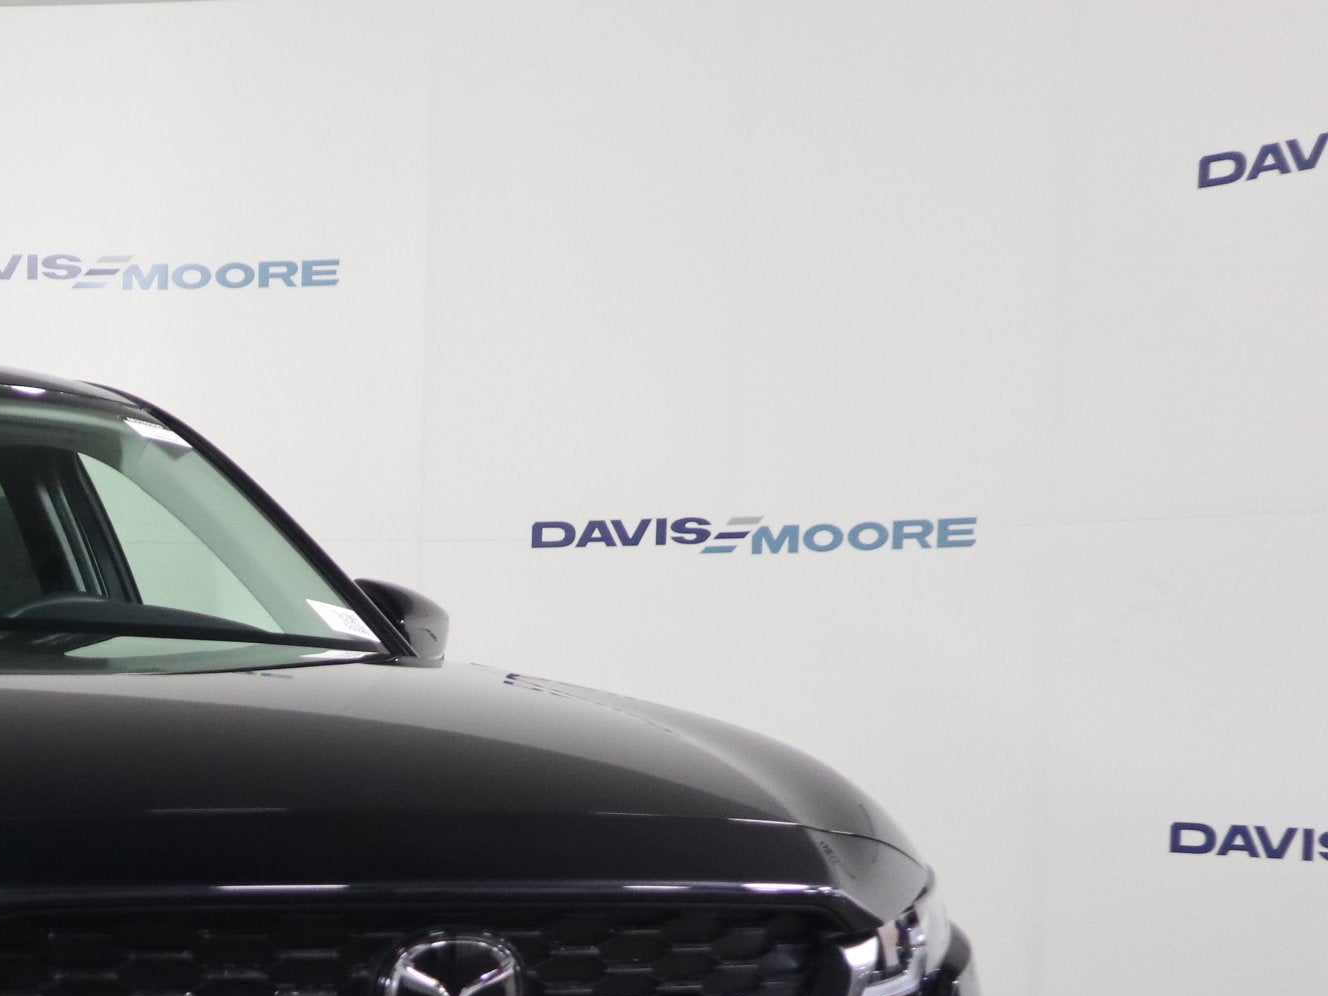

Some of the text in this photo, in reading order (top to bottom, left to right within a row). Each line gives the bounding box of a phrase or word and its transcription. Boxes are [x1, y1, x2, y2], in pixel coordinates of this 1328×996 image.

[122, 258, 341, 291] MOORE
[530, 516, 978, 555] DAVIS MOORE
[1169, 821, 1328, 862] DAVI
